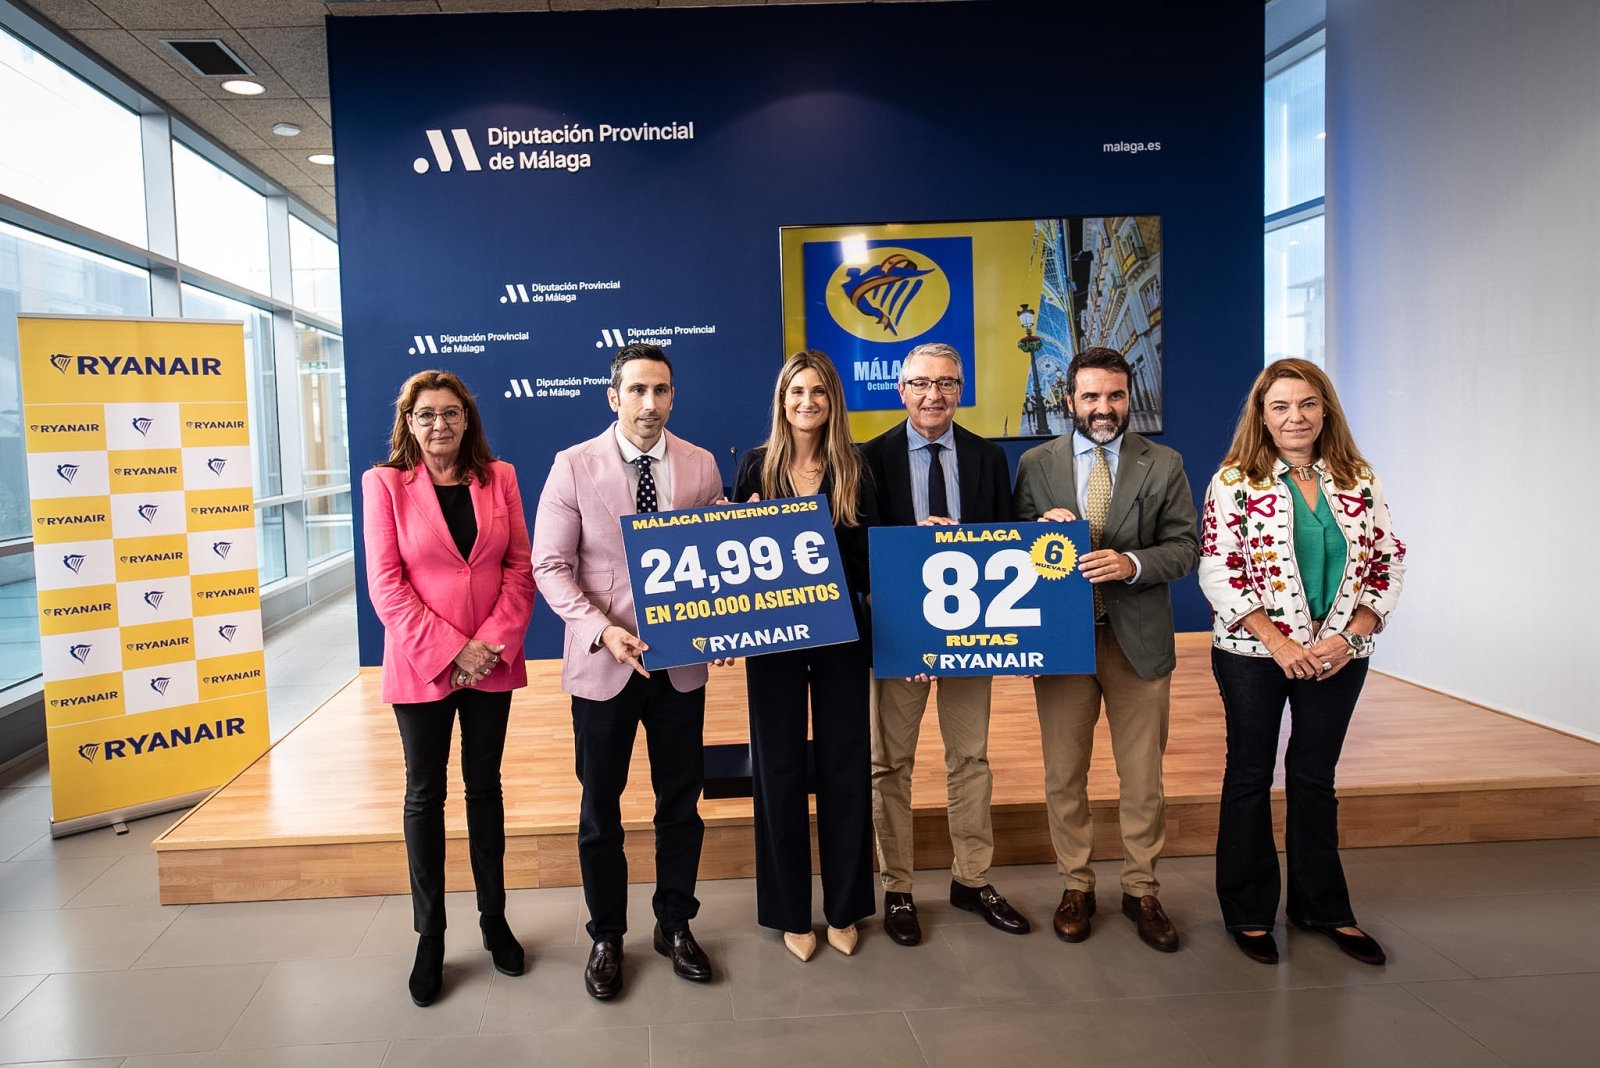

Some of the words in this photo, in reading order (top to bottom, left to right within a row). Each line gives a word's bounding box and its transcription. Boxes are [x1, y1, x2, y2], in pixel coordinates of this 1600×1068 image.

[488, 124, 594, 149] Diputación
[600, 122, 694, 142] Provincial
[1103, 141, 1161, 154] malaga.es
[489, 152, 514, 170] de
[519, 150, 591, 172] Málaga
[532, 282, 577, 293] Diputación
[579, 281, 620, 290] Provincial
[545, 293, 576, 303] Málaga
[440, 333, 486, 344] Diputación
[488, 332, 529, 341] Provincial
[628, 327, 672, 338] Diputación
[675, 325, 715, 334] Provincial
[441, 345, 452, 353] de
[454, 344, 485, 354] Málaga
[77, 356, 222, 376] RYANAIR
[536, 377, 581, 388] Diputación
[867, 382, 898, 391] Octubre
[550, 388, 580, 397] Málaga
[41, 423, 99, 433] RYANAIR
[195, 420, 244, 429] RYANAIR
[124, 466, 177, 476] RYANAIR
[200, 505, 249, 515] RYANAIR
[632, 514, 702, 530] MÁLAGA
[704, 505, 778, 522] INVIERNO
[781, 501, 818, 514] 2026
[47, 514, 105, 525] RYANAIR
[935, 528, 1021, 543] MÁLAGA
[129, 552, 183, 564] RYANAIR
[1045, 540, 1064, 564] 6
[640, 536, 784, 595] 24,99
[792, 530, 829, 574] €
[1035, 562, 1067, 572] NUEVAS
[206, 587, 255, 598] RYANAIR
[922, 549, 1042, 631] 82
[53, 602, 111, 616] RYANAIR
[645, 604, 672, 625] EN
[675, 594, 750, 621] 200.000
[754, 582, 840, 610] ASIENTOS
[136, 637, 189, 651] RYANAIR
[710, 624, 810, 653] RYANAIR
[946, 634, 1019, 647] RUTAS
[940, 652, 1044, 669] RYANAIR
[211, 670, 260, 684] RYANAIR
[60, 691, 118, 707] RYANAIR
[105, 717, 246, 761] RYANAIR
